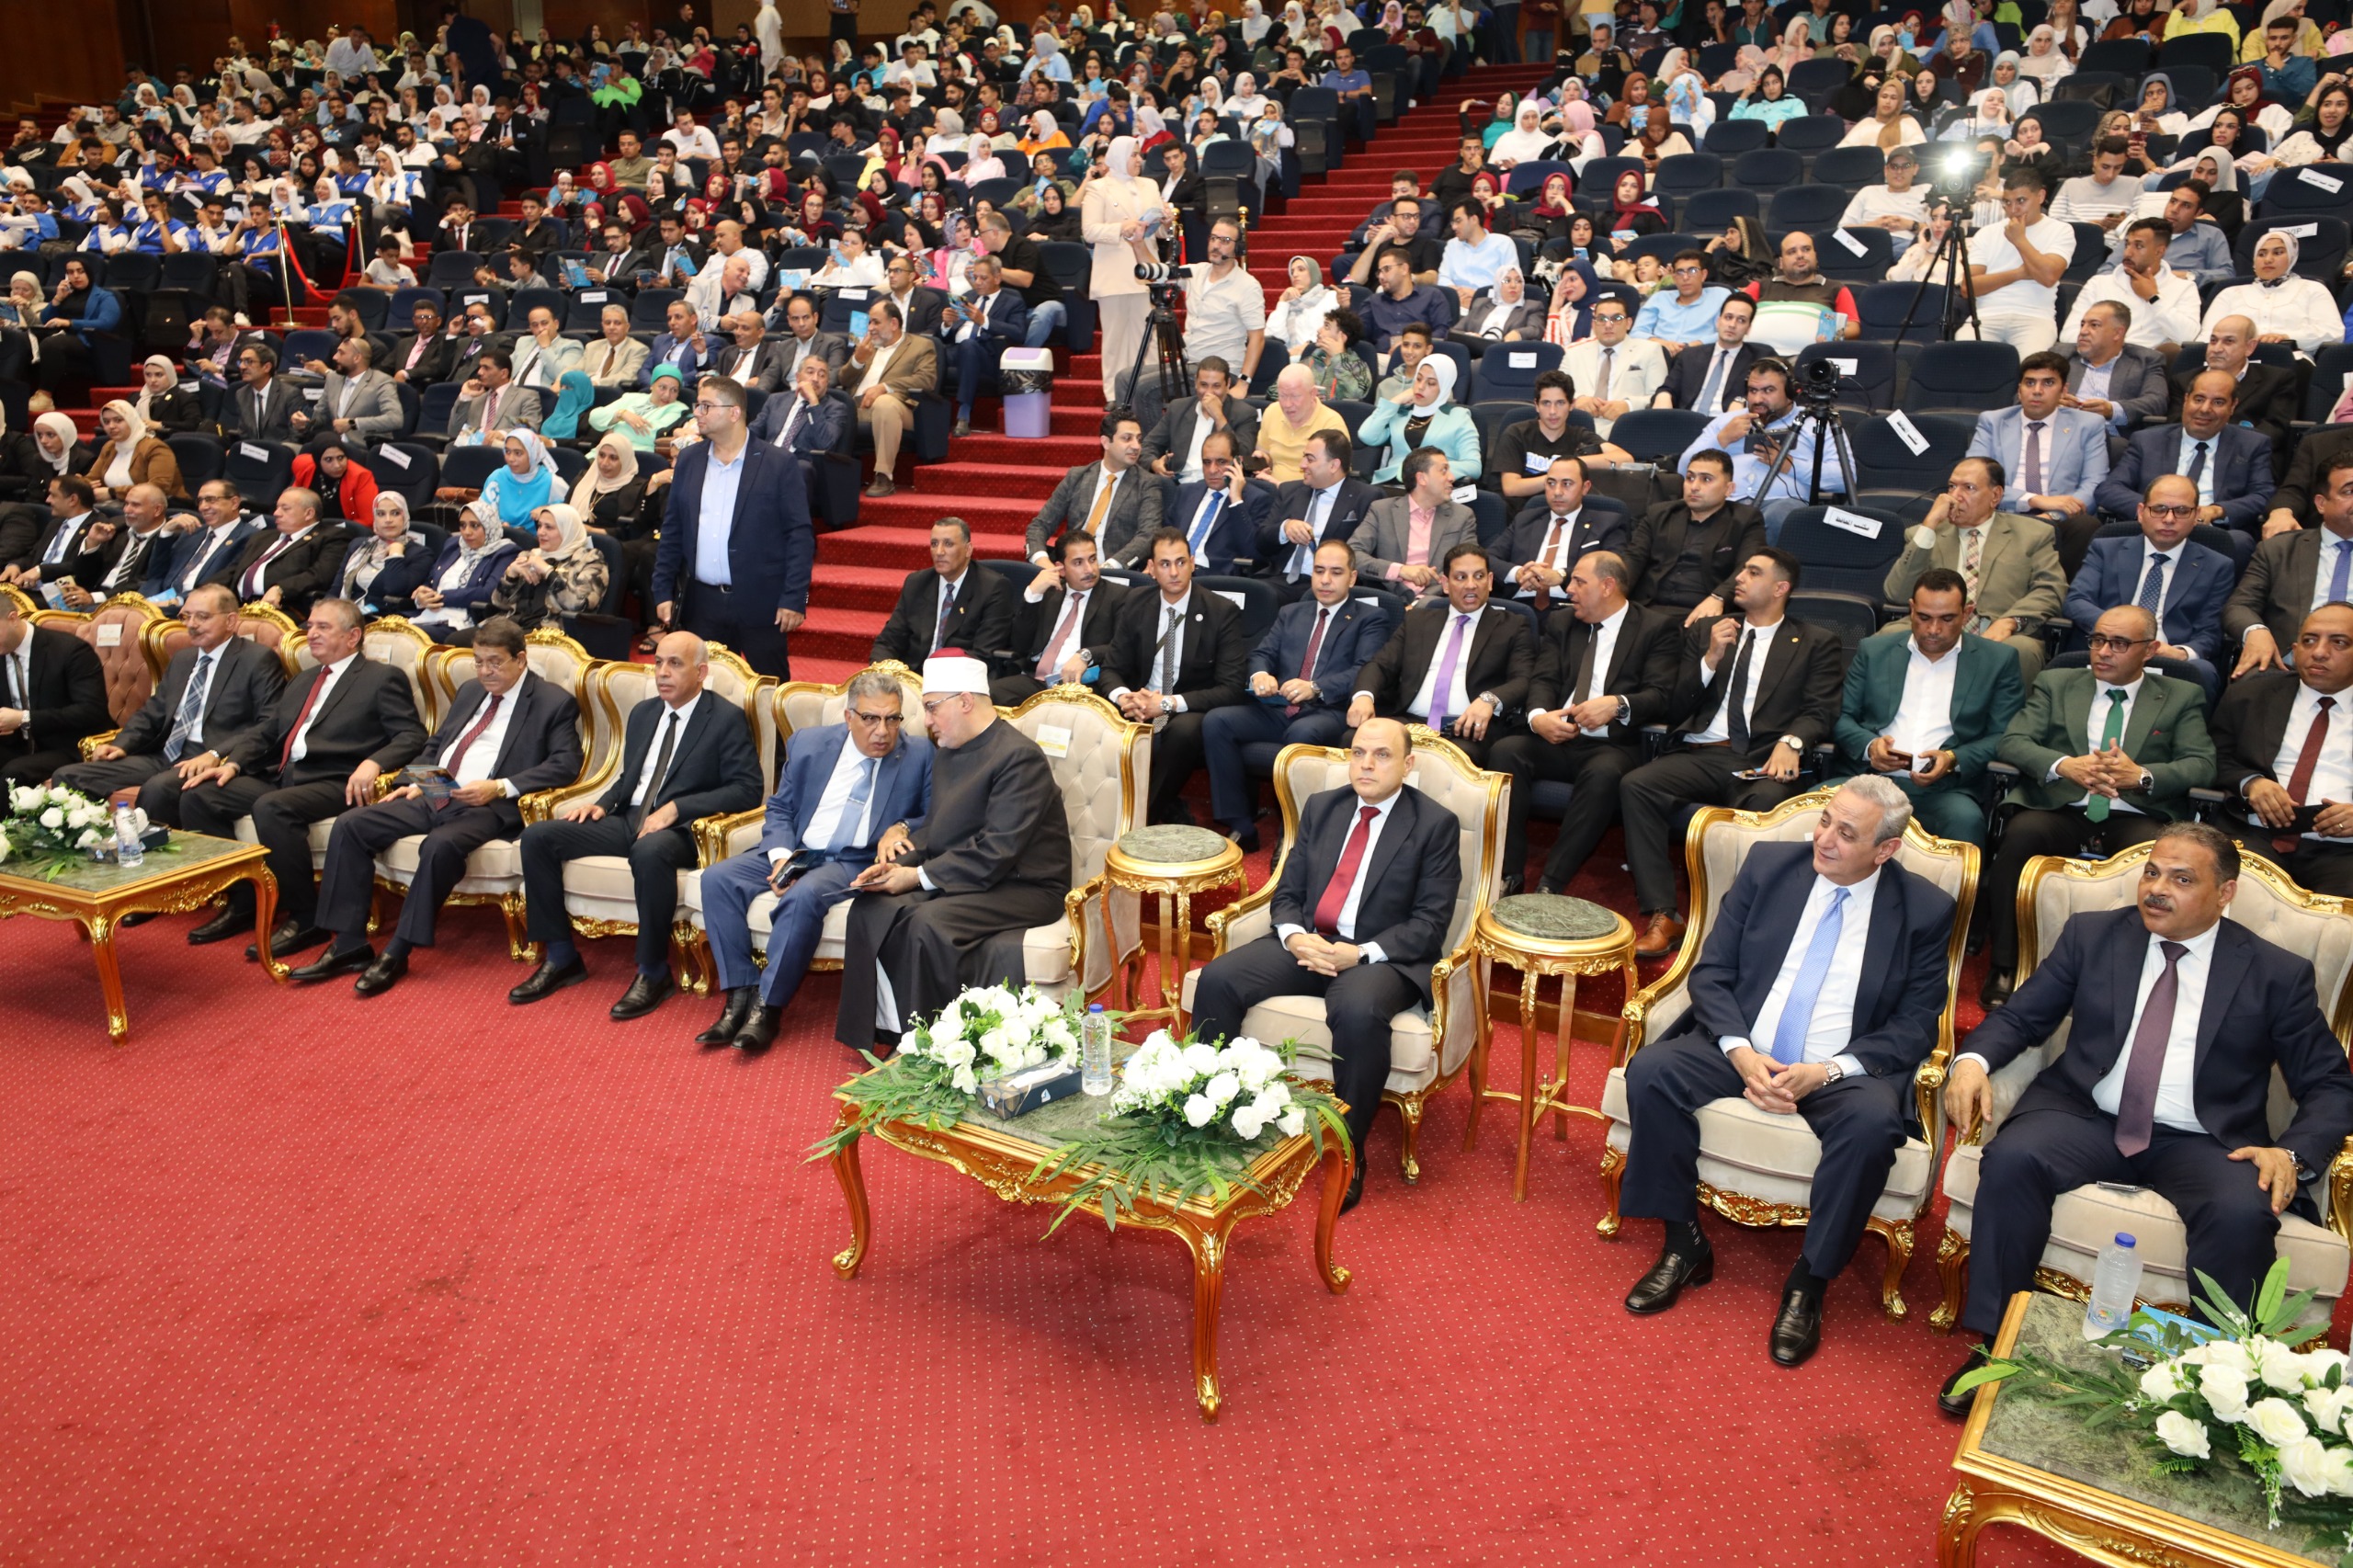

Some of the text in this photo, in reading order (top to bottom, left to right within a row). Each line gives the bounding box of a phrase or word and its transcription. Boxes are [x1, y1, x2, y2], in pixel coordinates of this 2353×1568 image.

[2287, 227, 2302, 235] VIP
[1835, 516, 1870, 531] مكتب المحافظ
